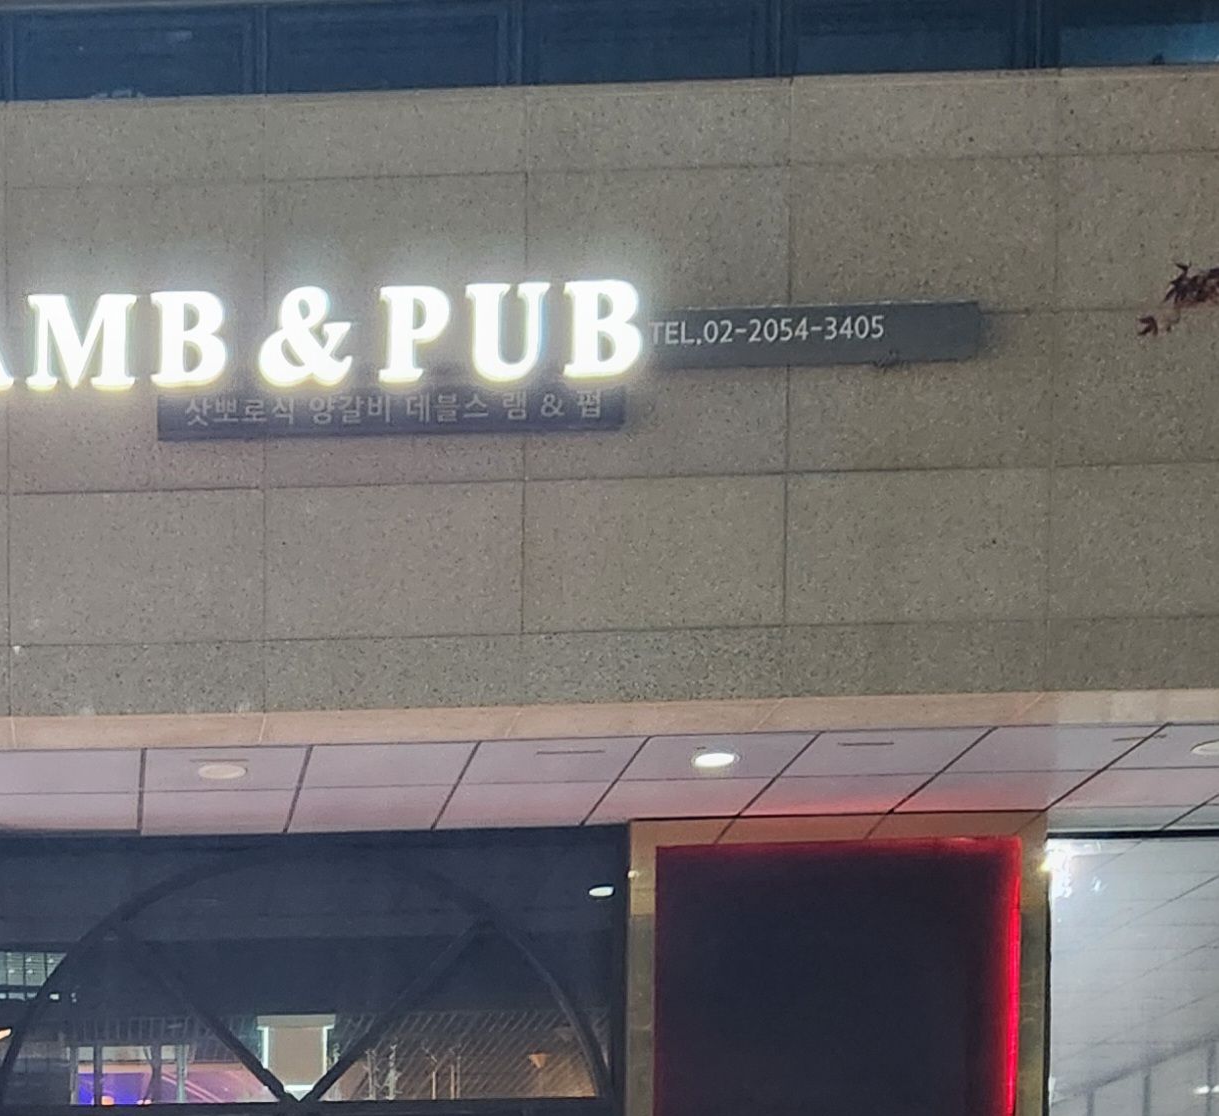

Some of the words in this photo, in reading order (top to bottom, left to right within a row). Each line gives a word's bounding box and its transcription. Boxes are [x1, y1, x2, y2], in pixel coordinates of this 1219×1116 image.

[259, 285, 353, 387] &
[379, 279, 642, 383] PUB
[651, 315, 884, 345] TEL.02-2054-3405
[309, 394, 390, 424] 양갈비
[406, 392, 489, 422] 데블스
[502, 390, 527, 420] 램
[541, 393, 565, 417] &
[577, 388, 601, 418] 펍
